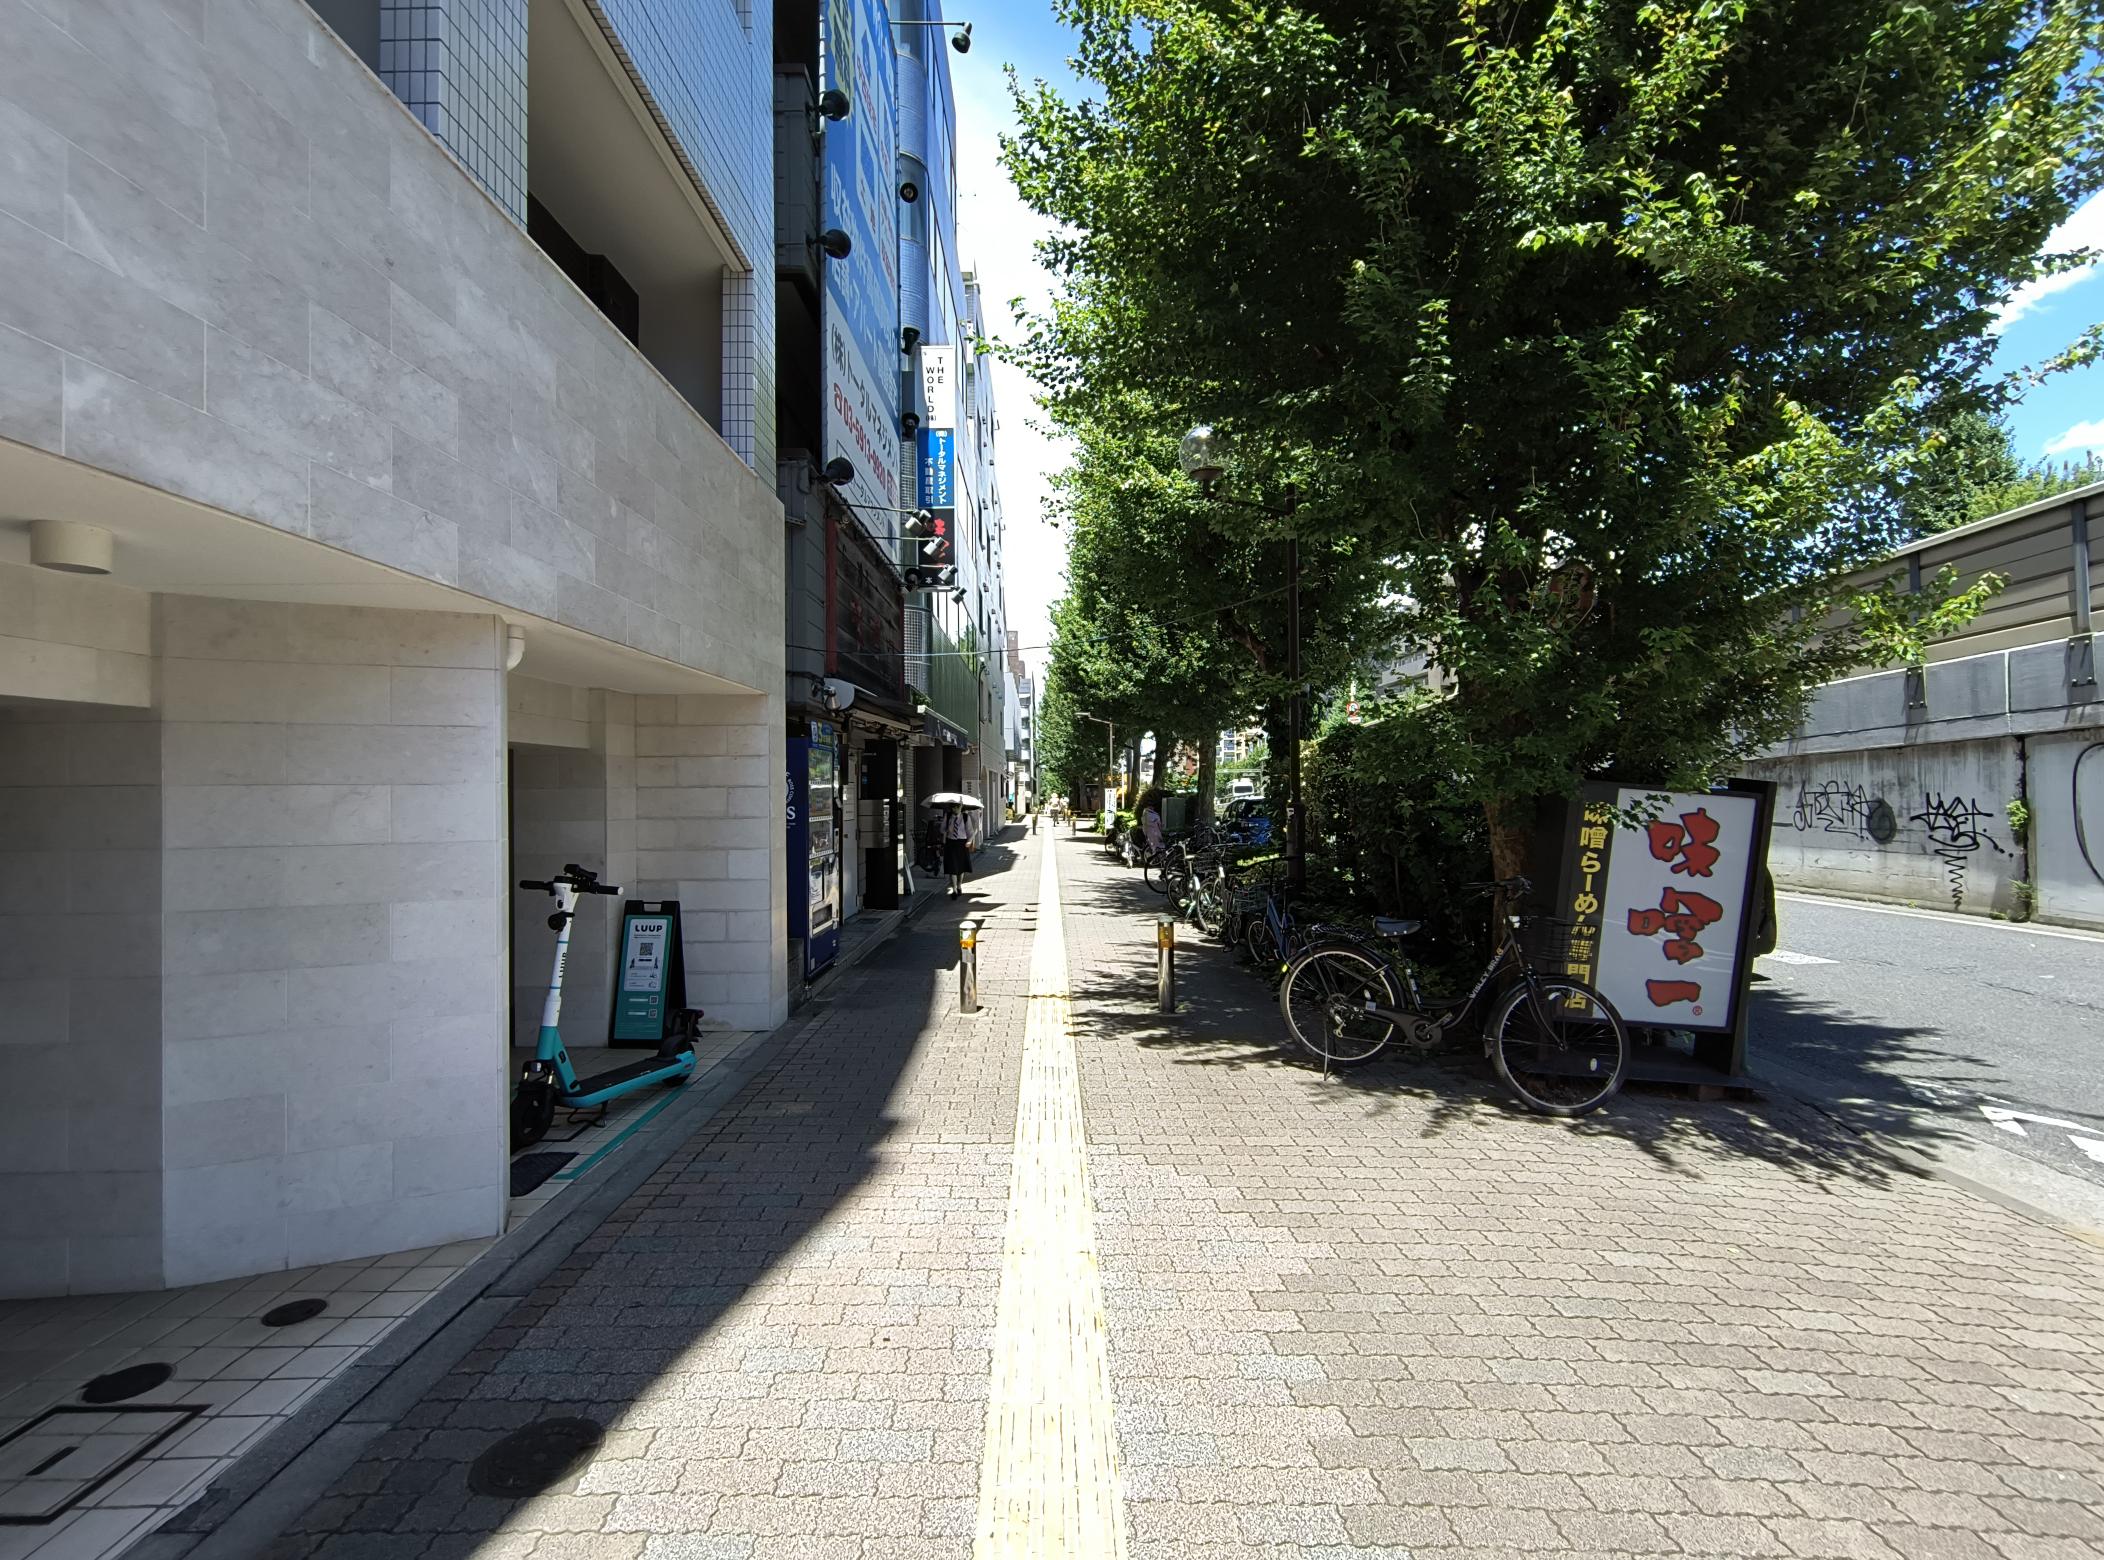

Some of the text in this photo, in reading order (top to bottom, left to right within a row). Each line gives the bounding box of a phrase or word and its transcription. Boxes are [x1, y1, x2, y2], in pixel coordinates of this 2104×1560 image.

[635, 924, 663, 932] LUUP
[1627, 807, 1724, 1007] 味噌一
